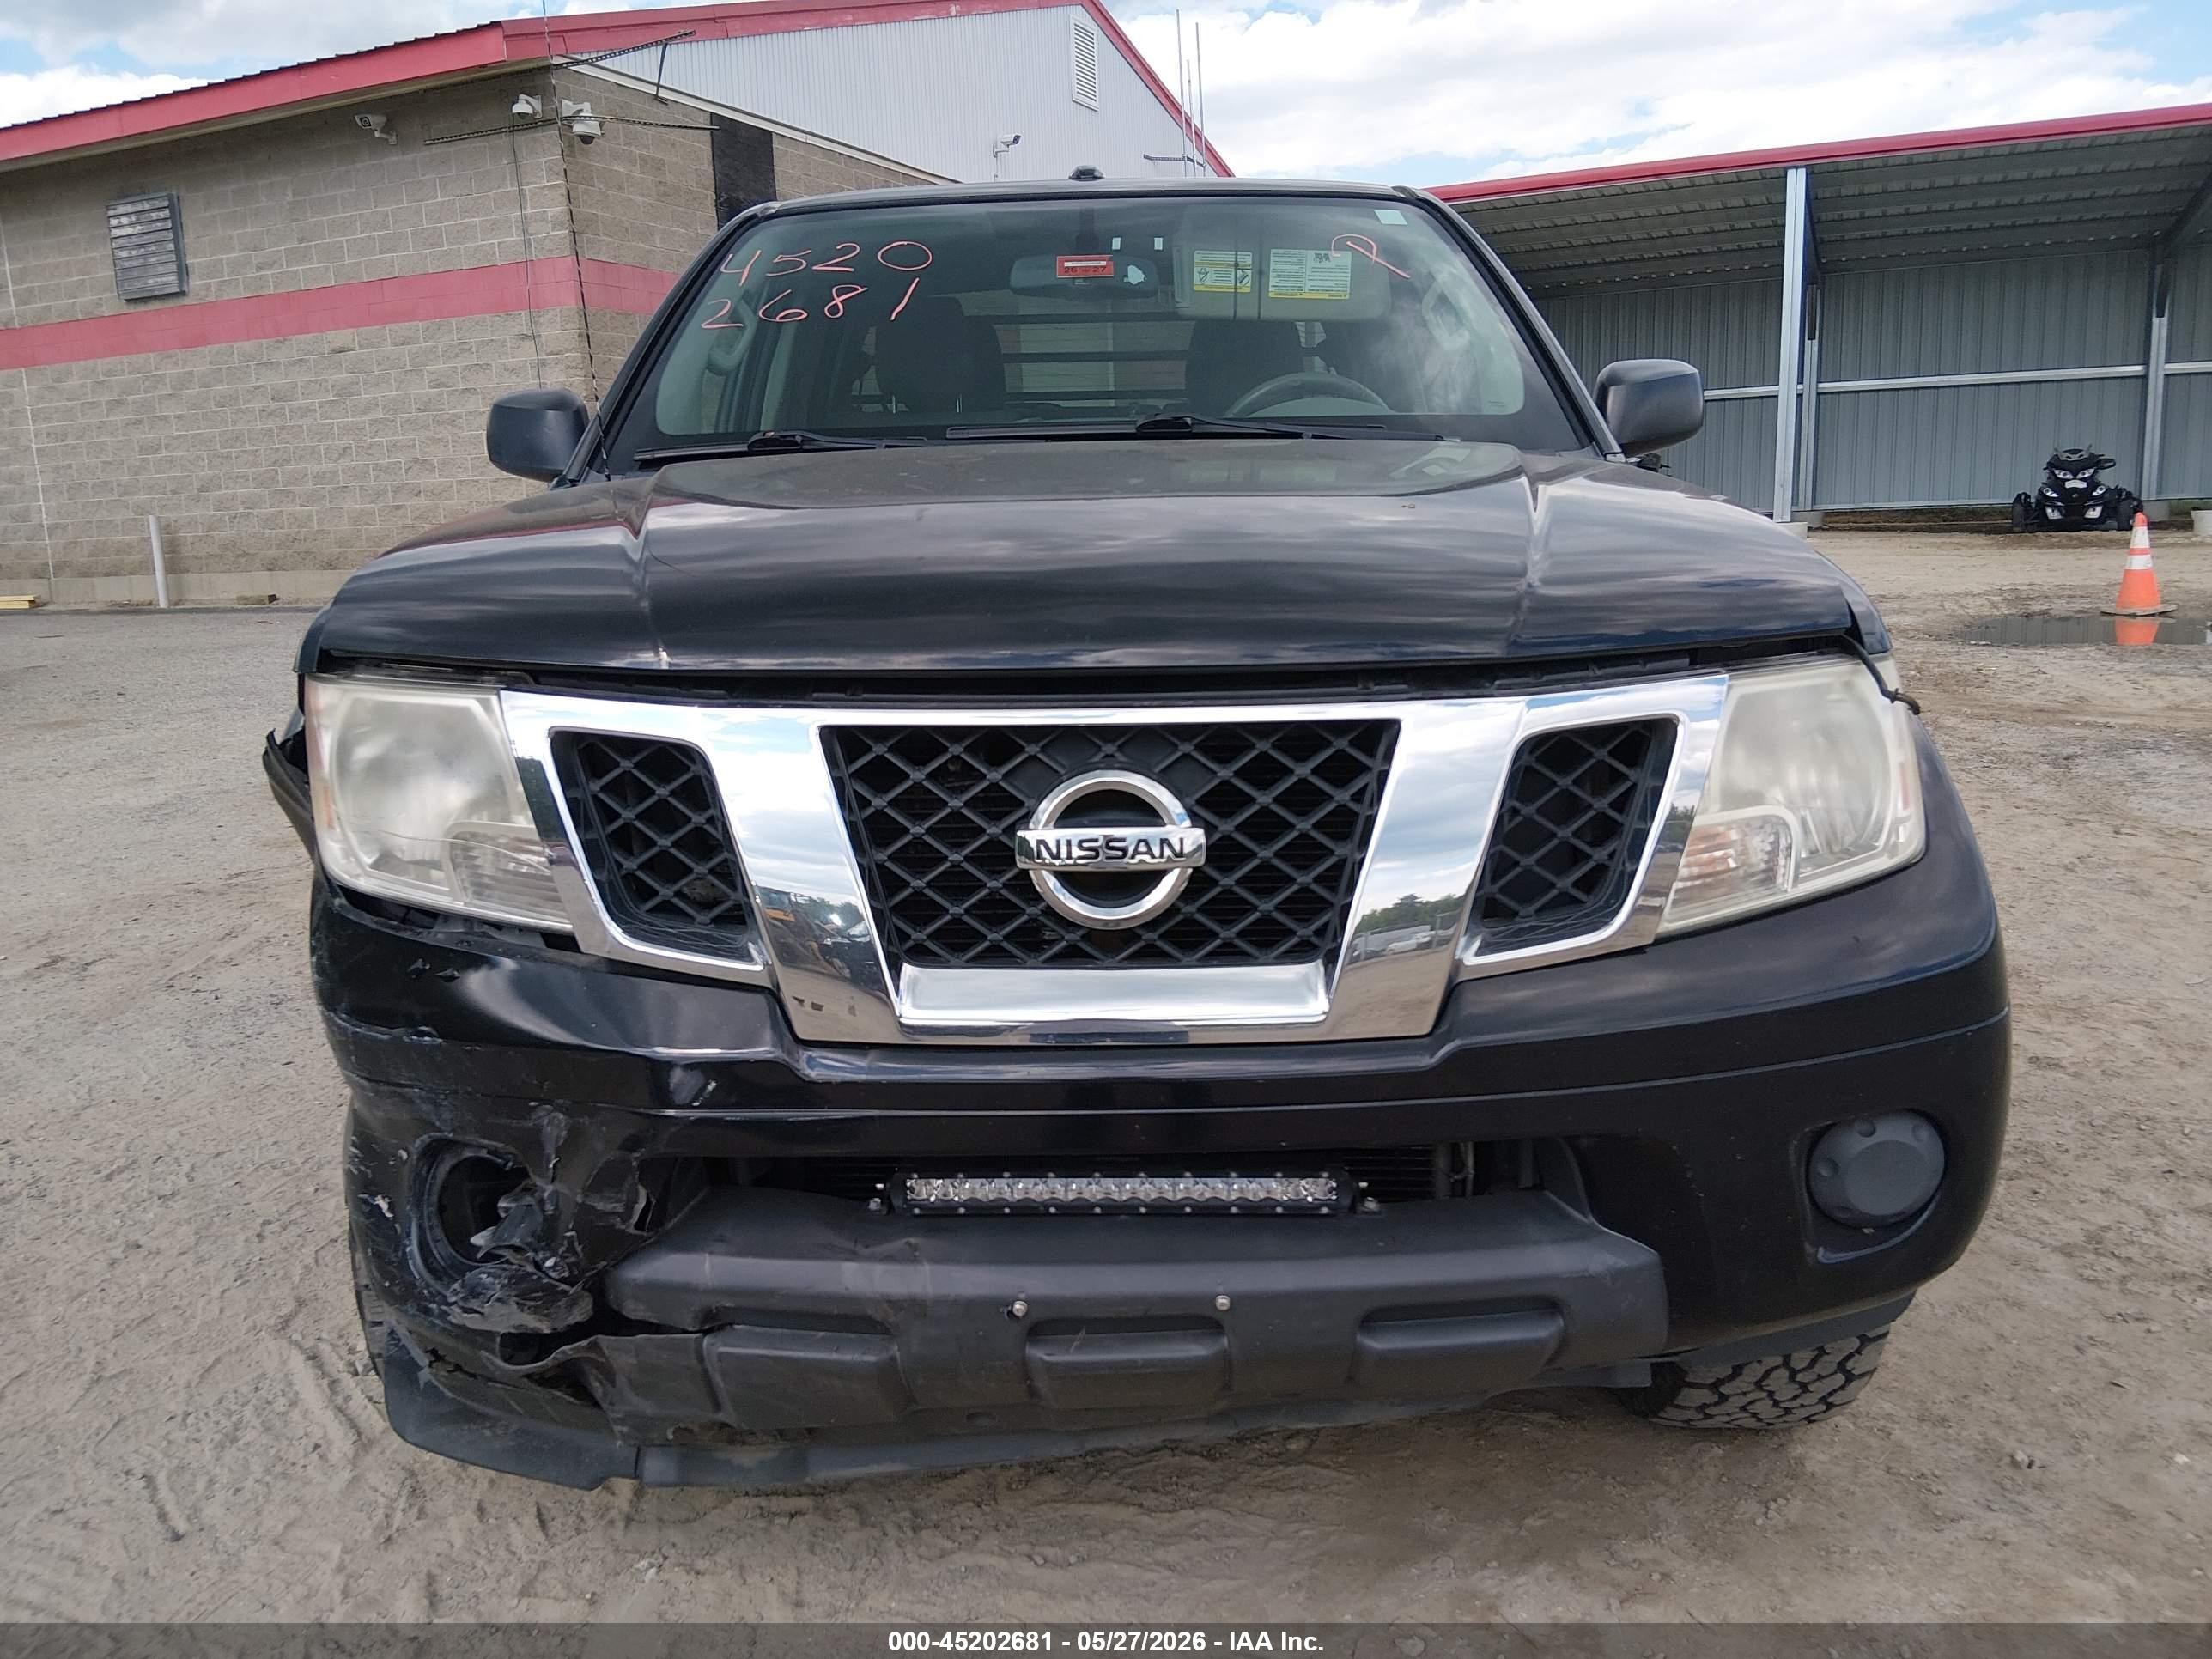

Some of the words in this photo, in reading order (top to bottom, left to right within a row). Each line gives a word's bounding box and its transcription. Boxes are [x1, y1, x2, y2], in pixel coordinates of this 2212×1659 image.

[720, 240, 933, 287] 4520
[701, 276, 920, 328] 2681
[1035, 836, 1186, 861] NISSAN
